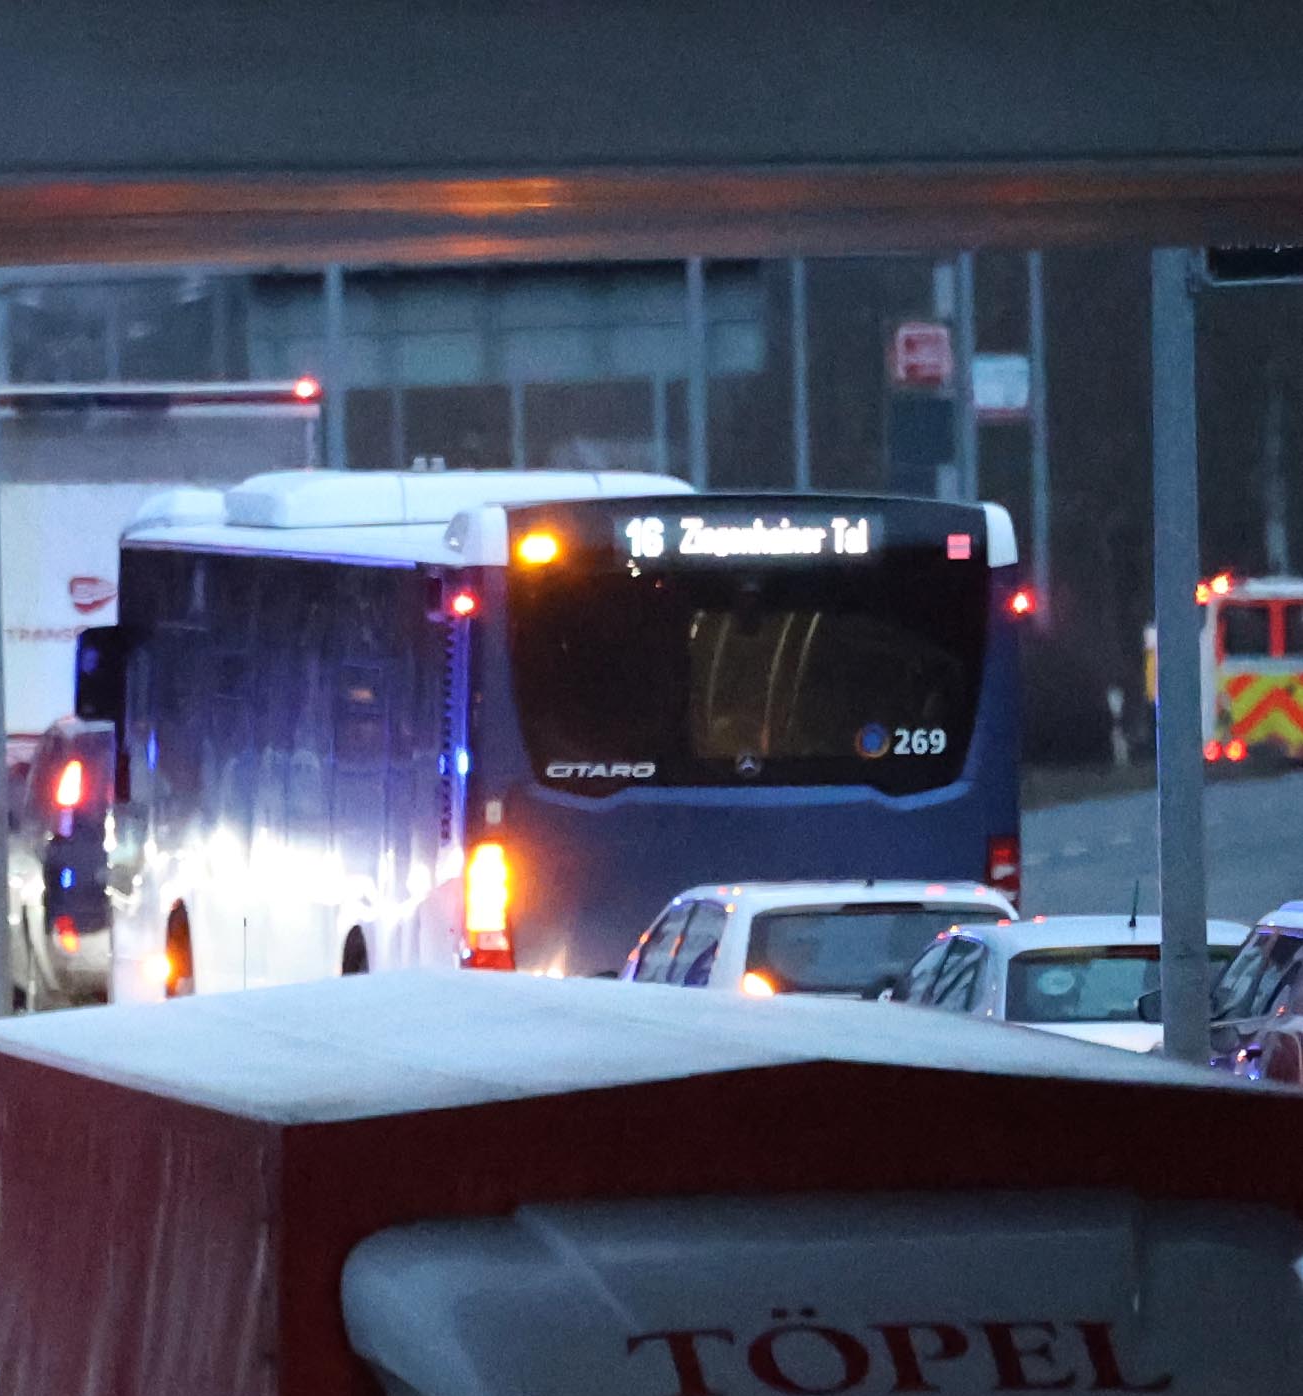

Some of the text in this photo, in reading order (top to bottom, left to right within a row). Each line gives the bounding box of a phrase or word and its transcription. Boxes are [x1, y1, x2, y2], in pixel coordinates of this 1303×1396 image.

[625, 517, 664, 557] 16
[831, 517, 868, 554] Tal
[893, 729, 947, 755] 269
[545, 761, 656, 778] CITARO
